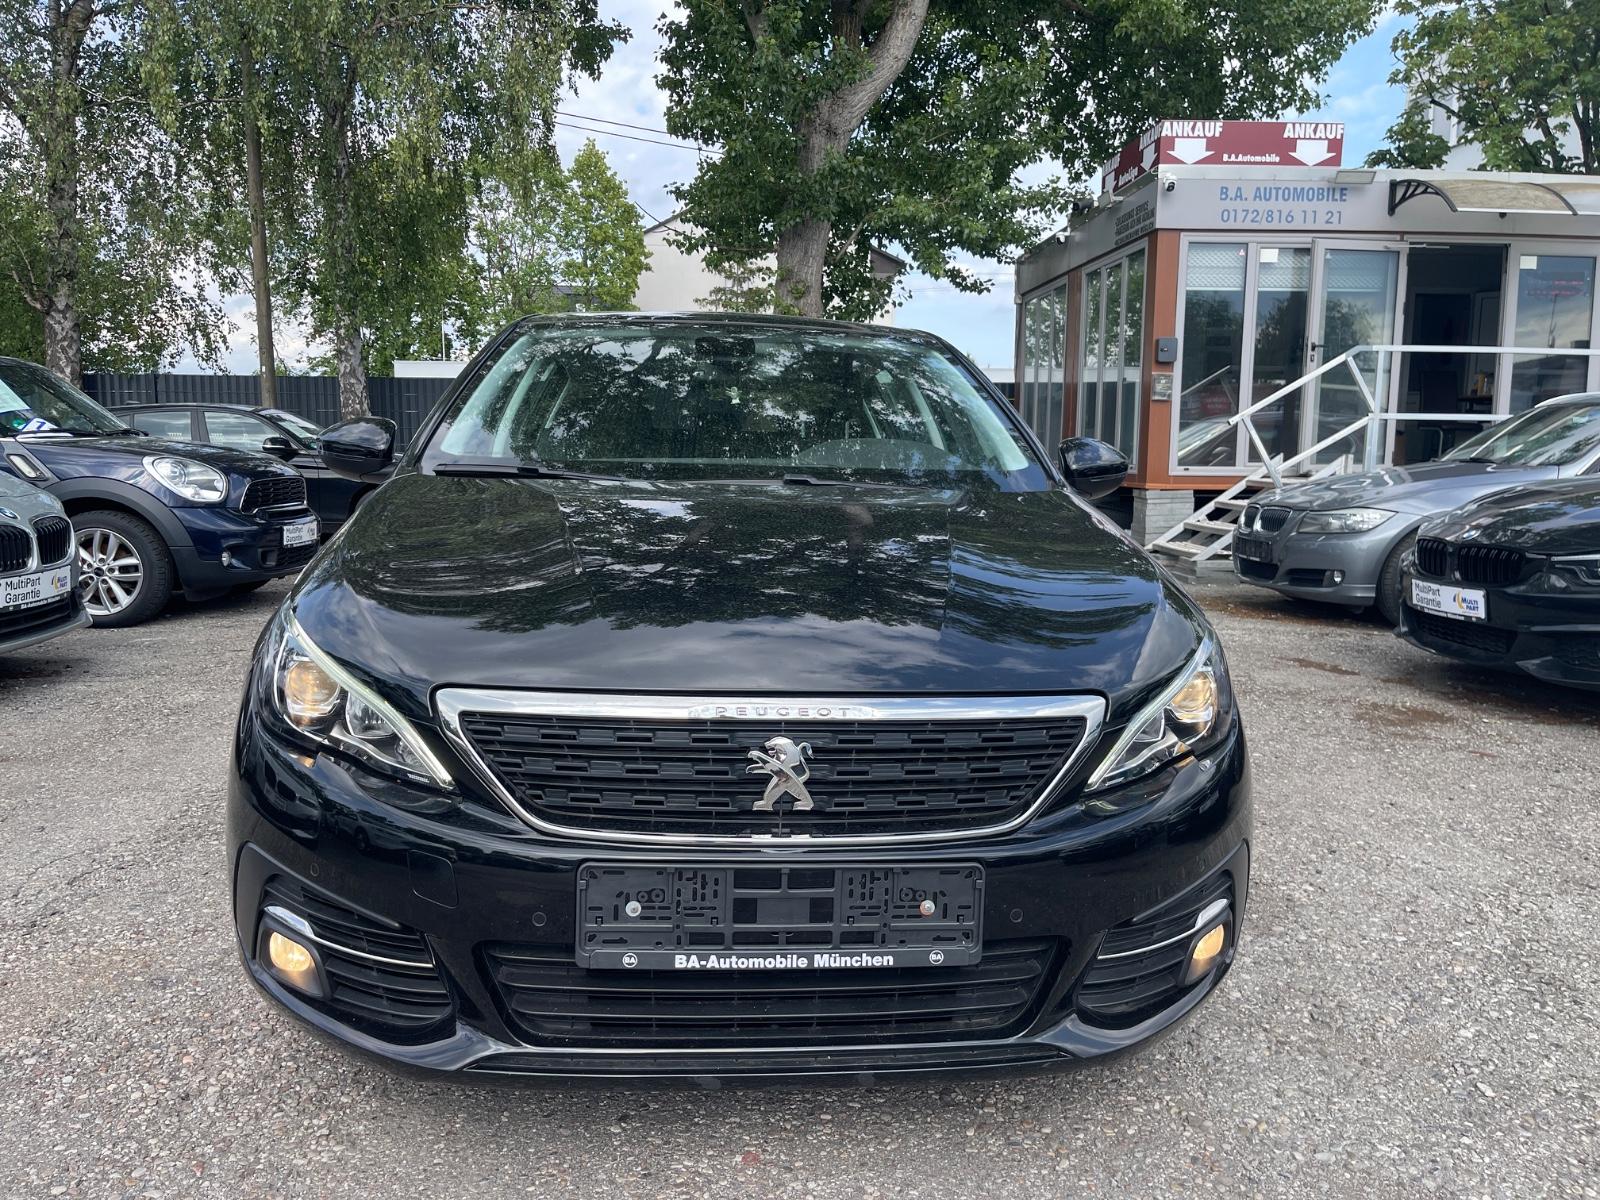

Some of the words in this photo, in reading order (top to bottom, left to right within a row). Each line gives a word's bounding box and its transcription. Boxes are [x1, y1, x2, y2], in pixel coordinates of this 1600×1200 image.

[1161, 121, 1223, 137] ANKAUF
[1283, 123, 1344, 139] ANKAUF
[1222, 153, 1280, 163] B.A.Automobile
[1219, 186, 1248, 201] B.A.
[1253, 186, 1348, 202] AUTOMOBILE
[1221, 209, 1294, 224] 0172/816
[1301, 210, 1317, 224] 11
[1324, 211, 1342, 224] 21
[5, 577, 41, 592] MultiPart
[1414, 582, 1441, 597] MultiPart
[5, 588, 41, 604] Garantie
[1415, 593, 1442, 609] Garantie
[1465, 604, 1479, 612] PART
[715, 706, 850, 717] PEUGEOT
[674, 954, 808, 969] BA-Automobile
[813, 953, 894, 967] München
